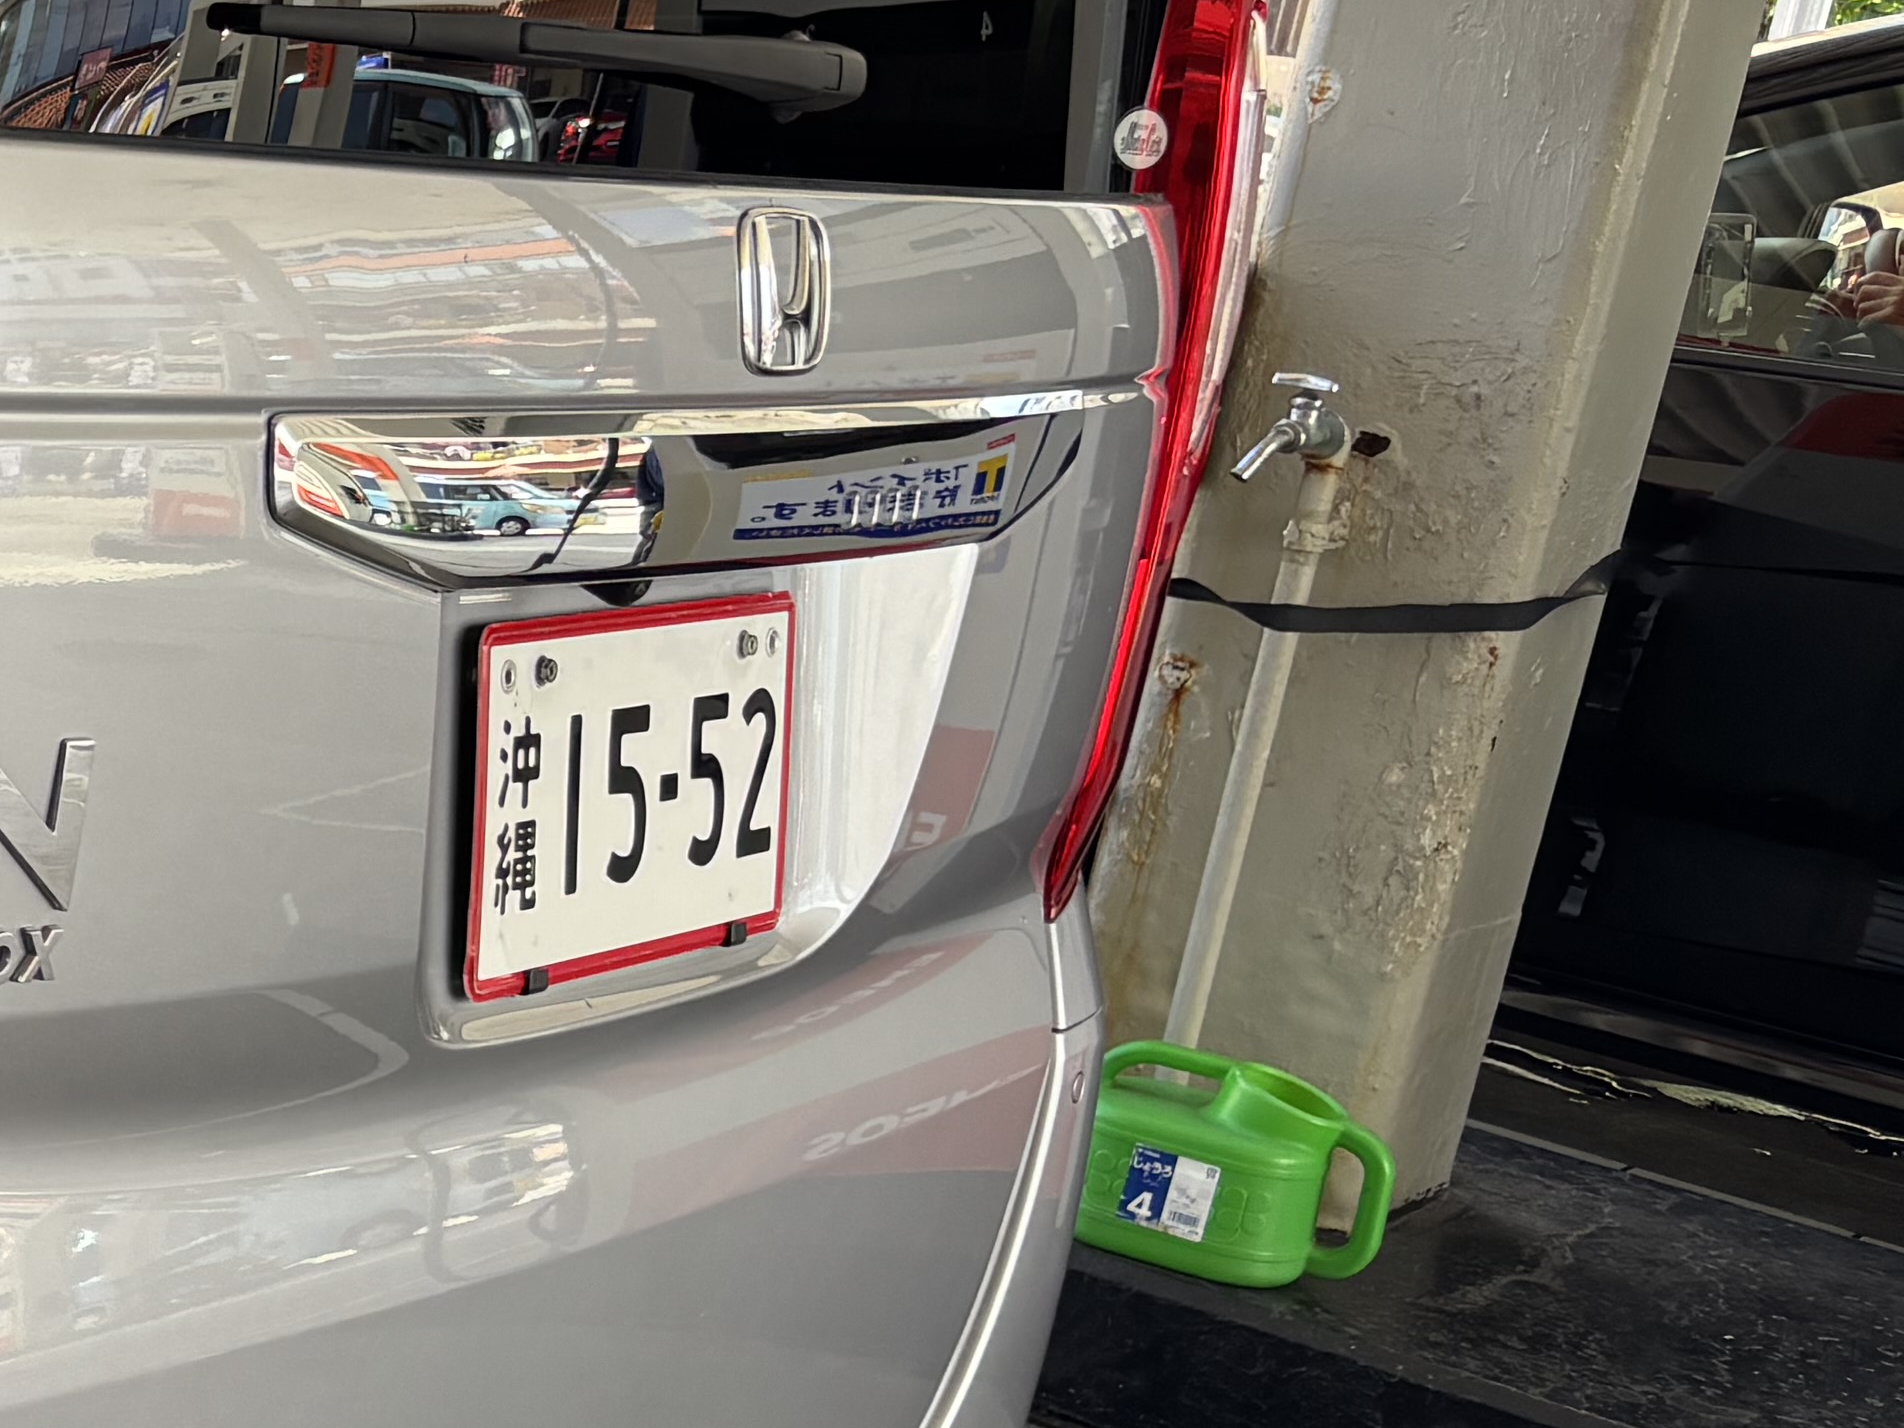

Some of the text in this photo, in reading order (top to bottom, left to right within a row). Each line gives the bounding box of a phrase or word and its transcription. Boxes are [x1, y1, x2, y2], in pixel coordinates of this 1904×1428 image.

[491, 715, 544, 916] 沖縄
[560, 684, 779, 898] 15-52
[1126, 1190, 1154, 1219] 4
